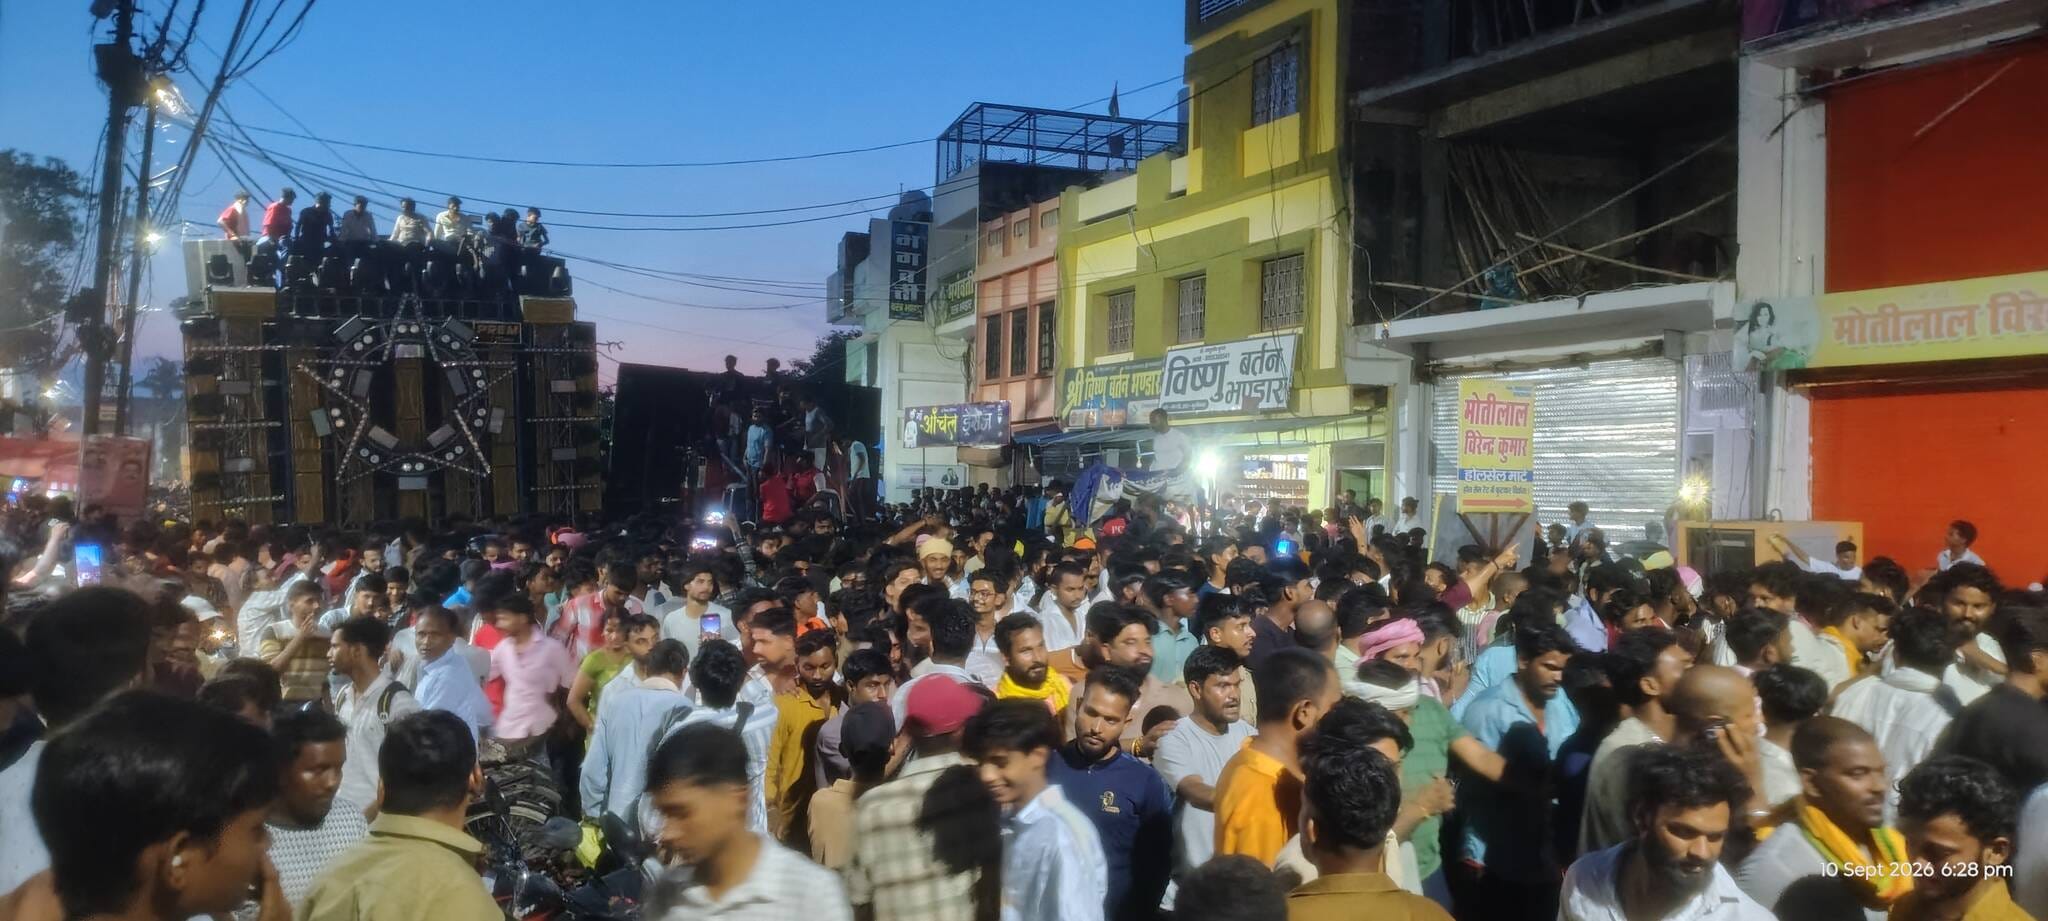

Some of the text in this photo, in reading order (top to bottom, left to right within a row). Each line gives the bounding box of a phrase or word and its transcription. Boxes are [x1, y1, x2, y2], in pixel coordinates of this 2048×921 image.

[1832, 290, 2048, 345] मोतीलाल विरे
[1062, 367, 1084, 419] श्री
[1165, 342, 1283, 402] विष्णु बर्तन
[1464, 392, 1529, 427] मोतीलाल
[1498, 437, 1529, 463] कुमार
